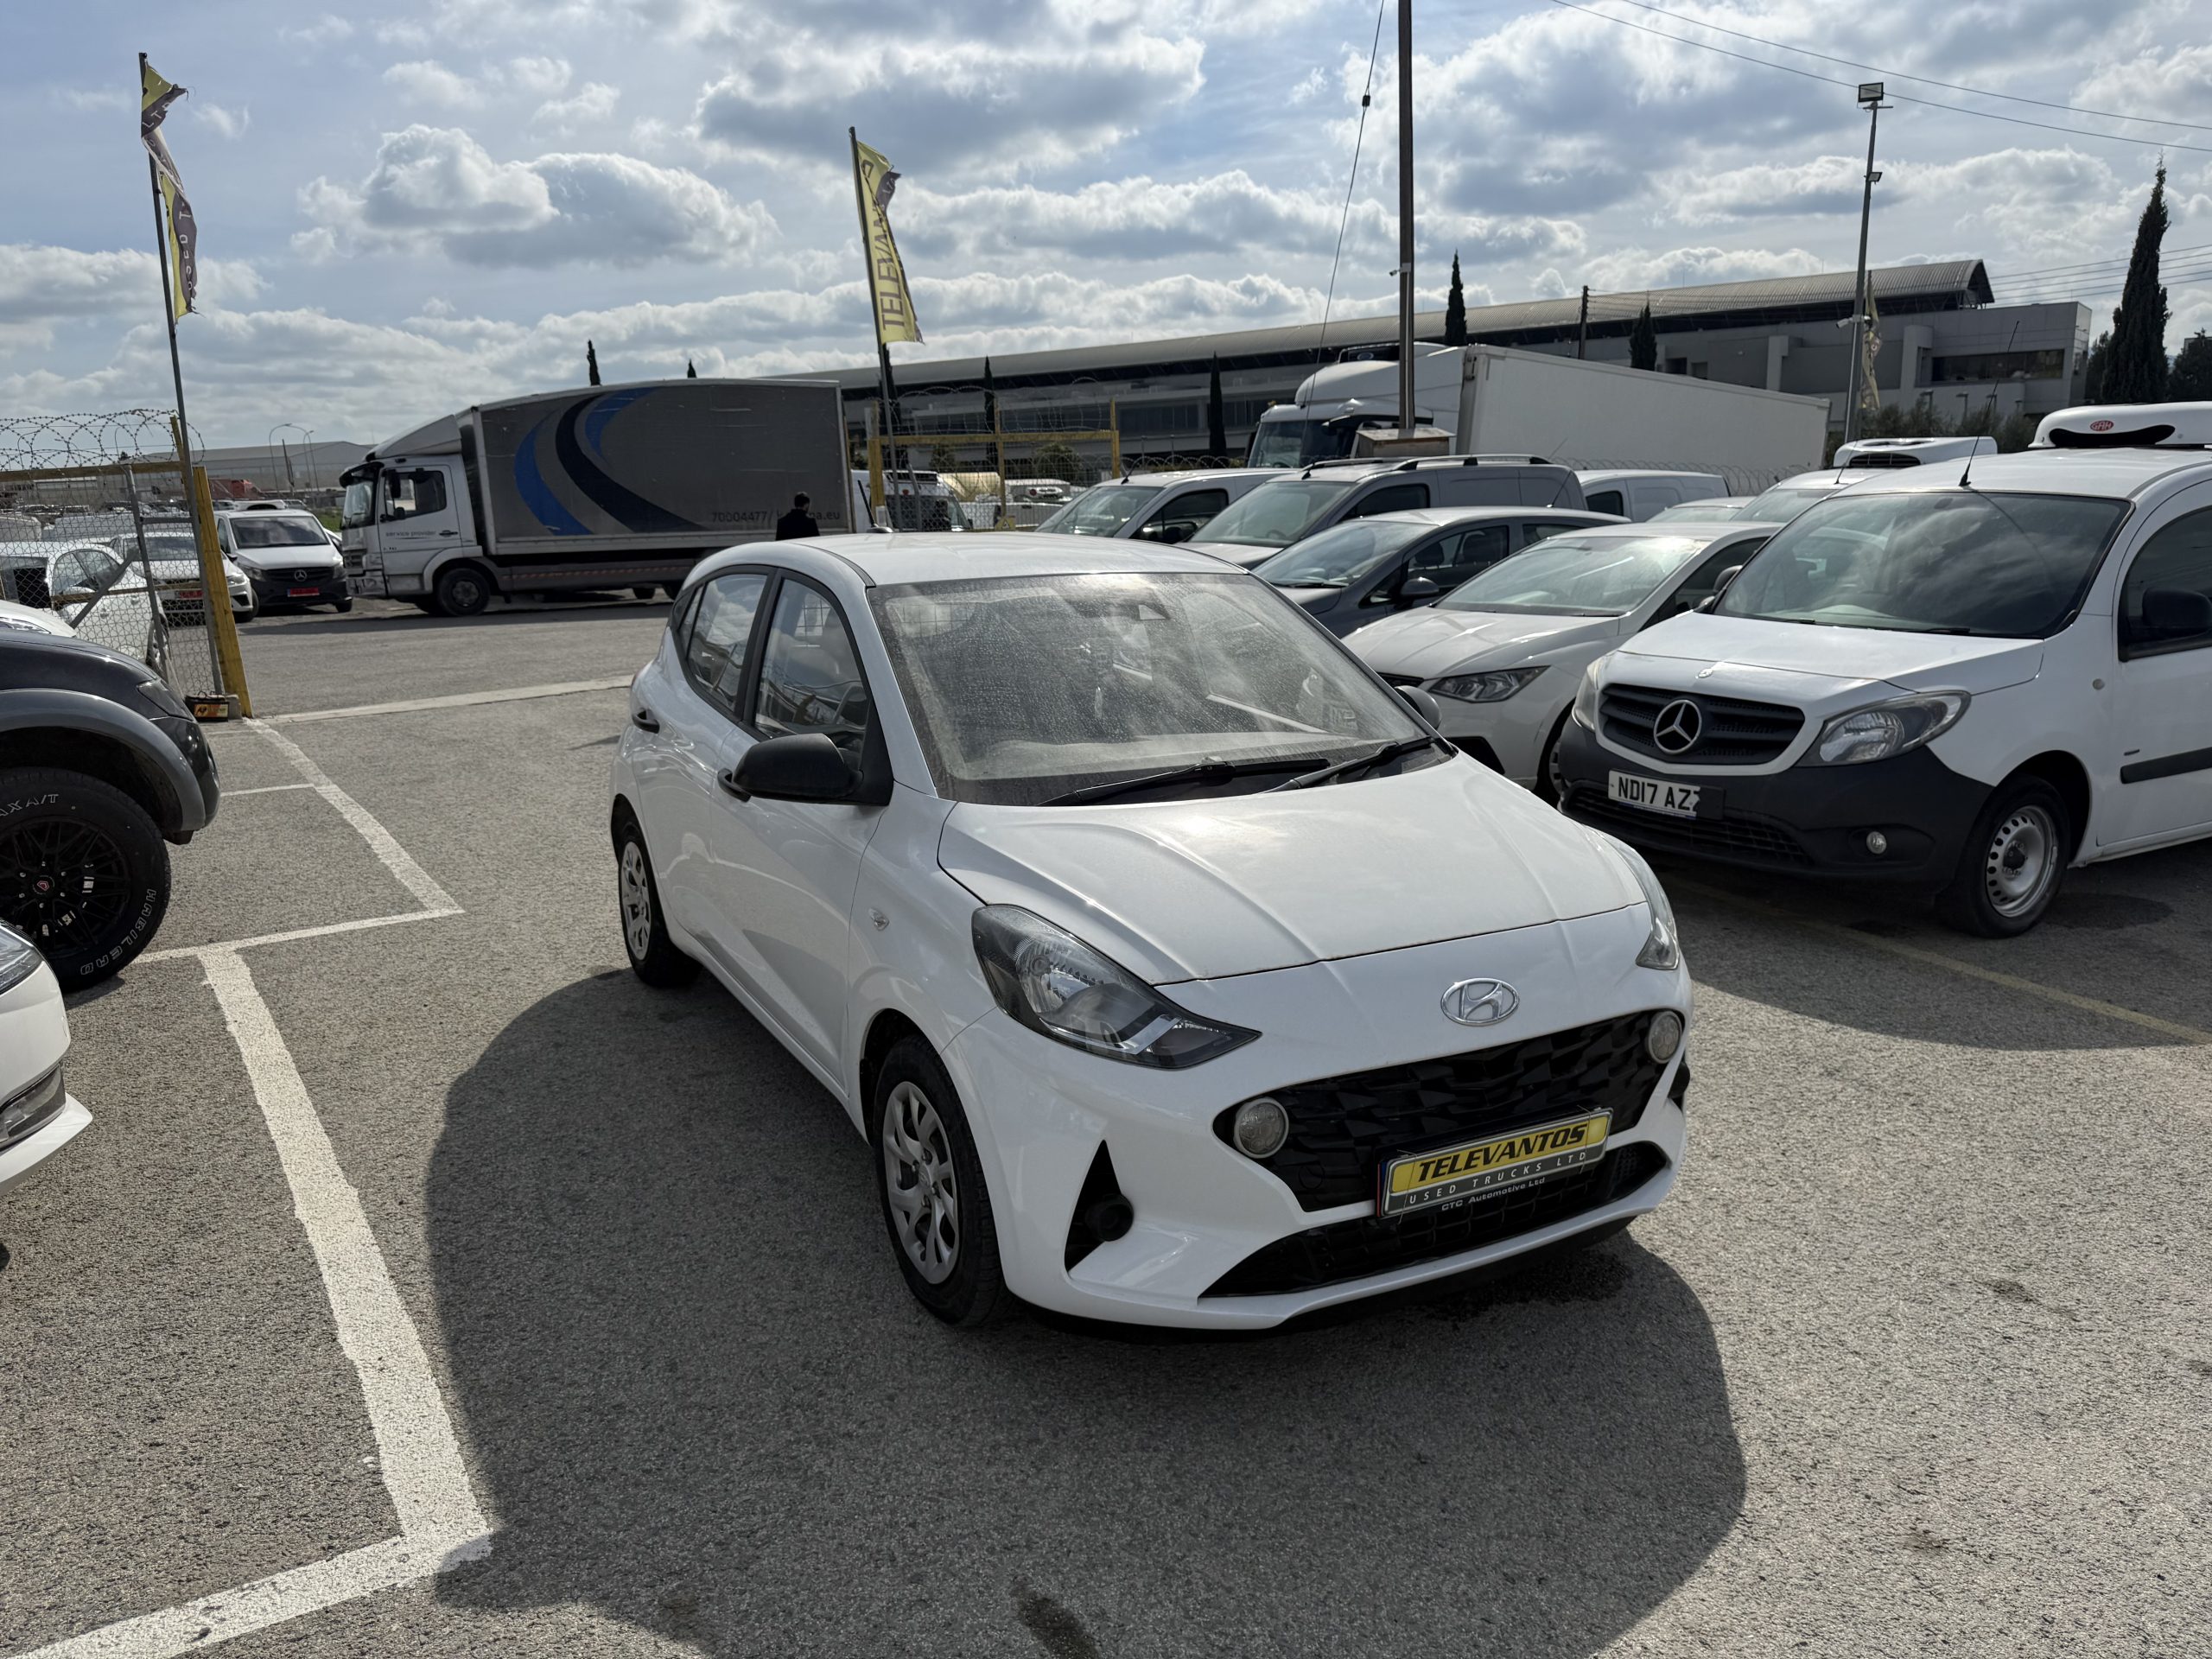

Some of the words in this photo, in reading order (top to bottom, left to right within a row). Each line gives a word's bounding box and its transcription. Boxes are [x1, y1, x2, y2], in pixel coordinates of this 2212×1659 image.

[25, 793, 59, 808] A/T
[1618, 776, 1658, 804] ND17
[80, 888, 156, 975] HABILEAD
[1417, 1123, 1588, 1182] TELEVANTOS
[1409, 1185, 1456, 1204] USED
[1471, 1162, 1542, 1187] TRUCKS
[1556, 1152, 1586, 1166] LTD
[1441, 1198, 1463, 1211] CTC
[1468, 1182, 1526, 1204] Automotive
[1528, 1177, 1546, 1187] Ltd
